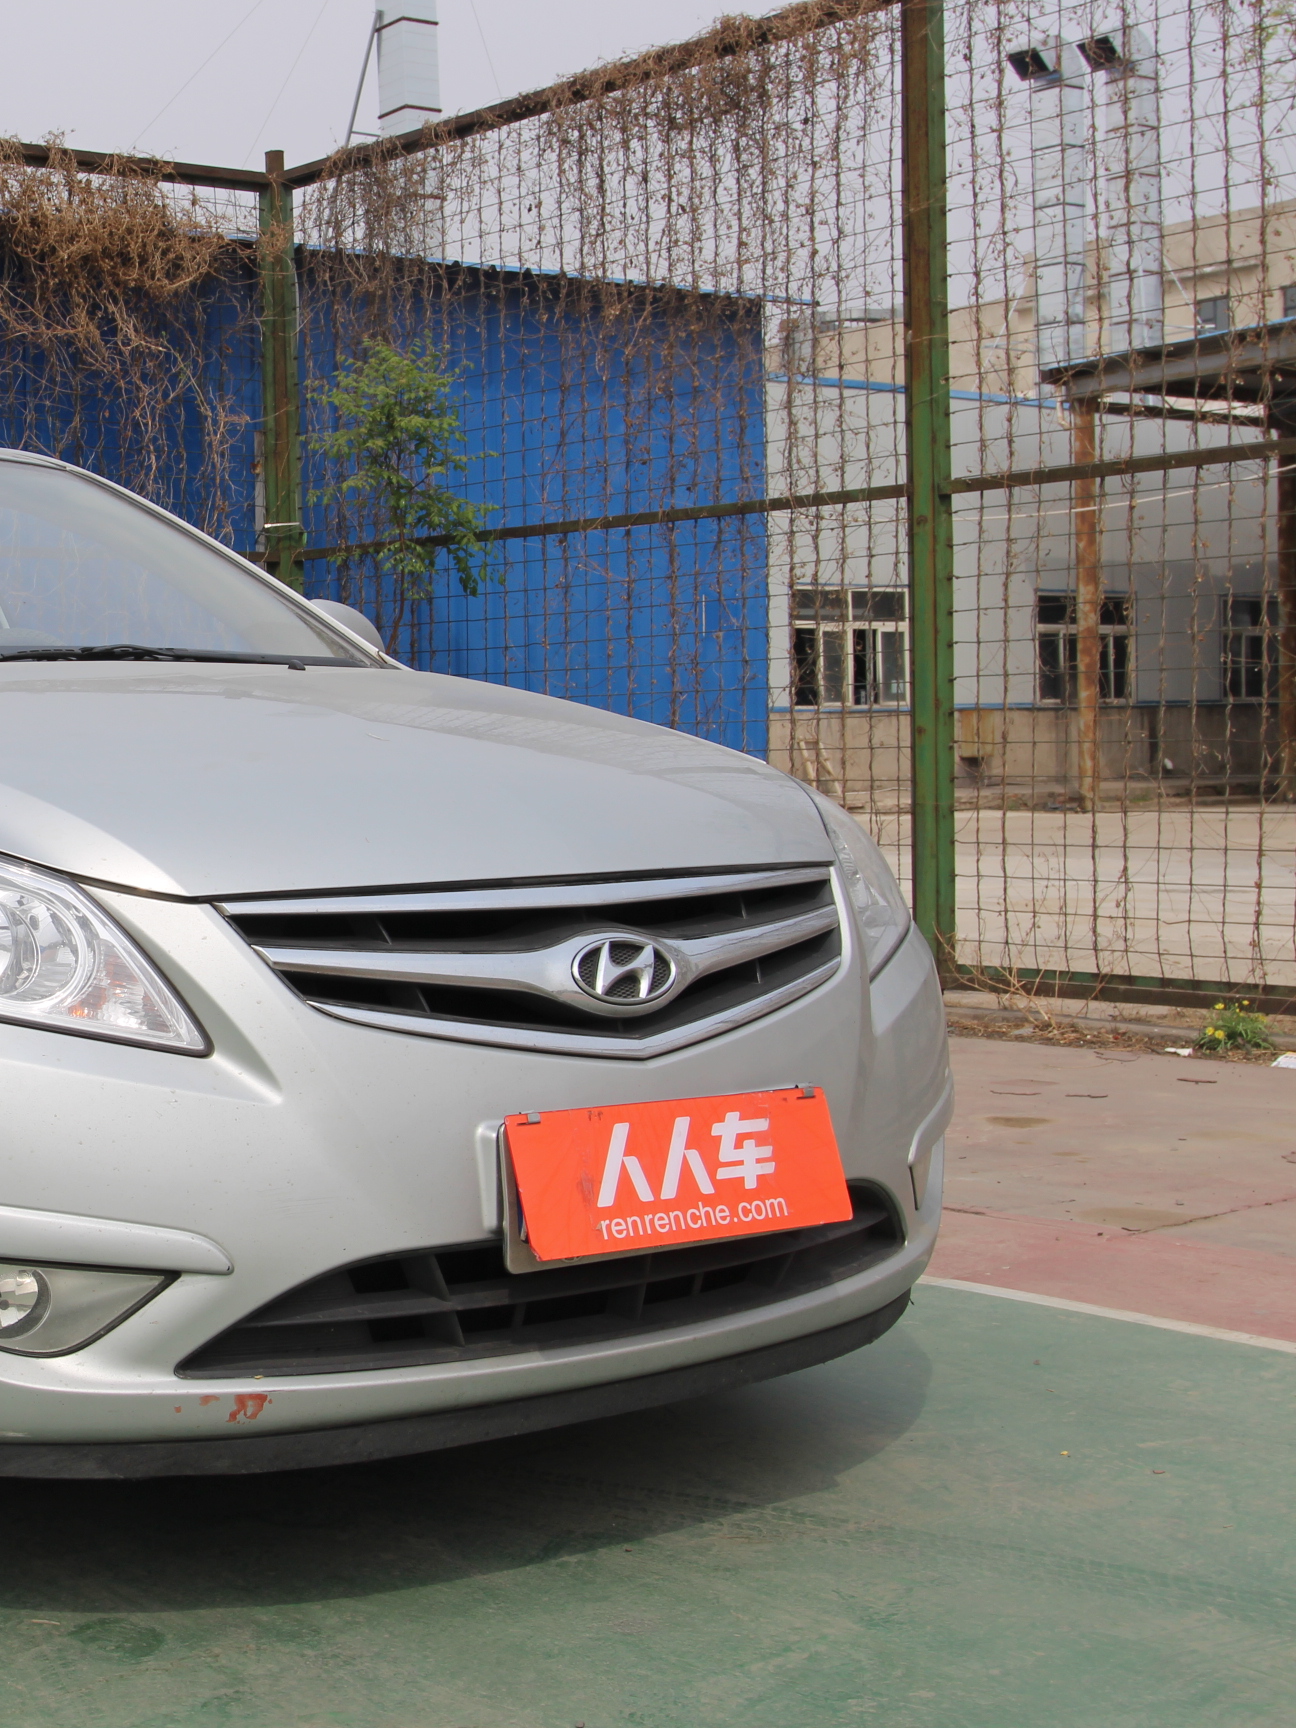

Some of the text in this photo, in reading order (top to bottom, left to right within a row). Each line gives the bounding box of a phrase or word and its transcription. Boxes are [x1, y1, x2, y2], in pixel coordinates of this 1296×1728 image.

[597, 1112, 775, 1207] 人人车
[601, 1197, 789, 1240] renrenche.com
